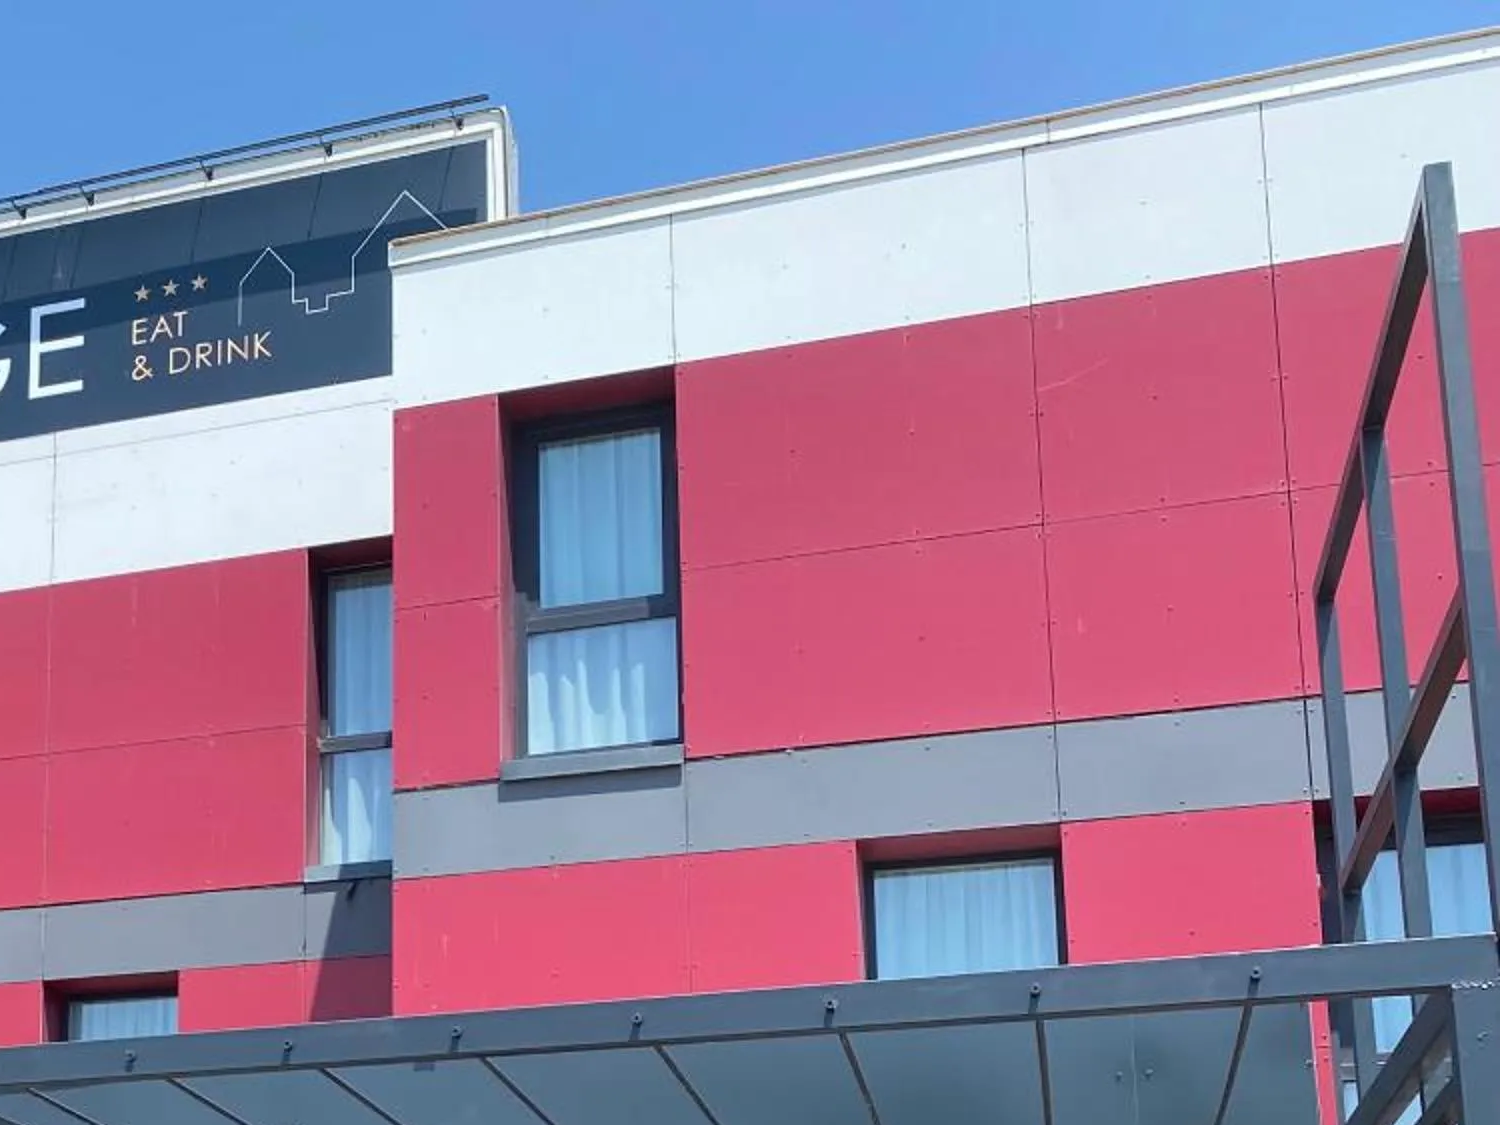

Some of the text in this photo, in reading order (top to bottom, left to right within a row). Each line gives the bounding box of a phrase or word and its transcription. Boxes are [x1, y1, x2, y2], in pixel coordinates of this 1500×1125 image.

[132, 311, 188, 346] EAT
[130, 331, 274, 382] & DRINK
